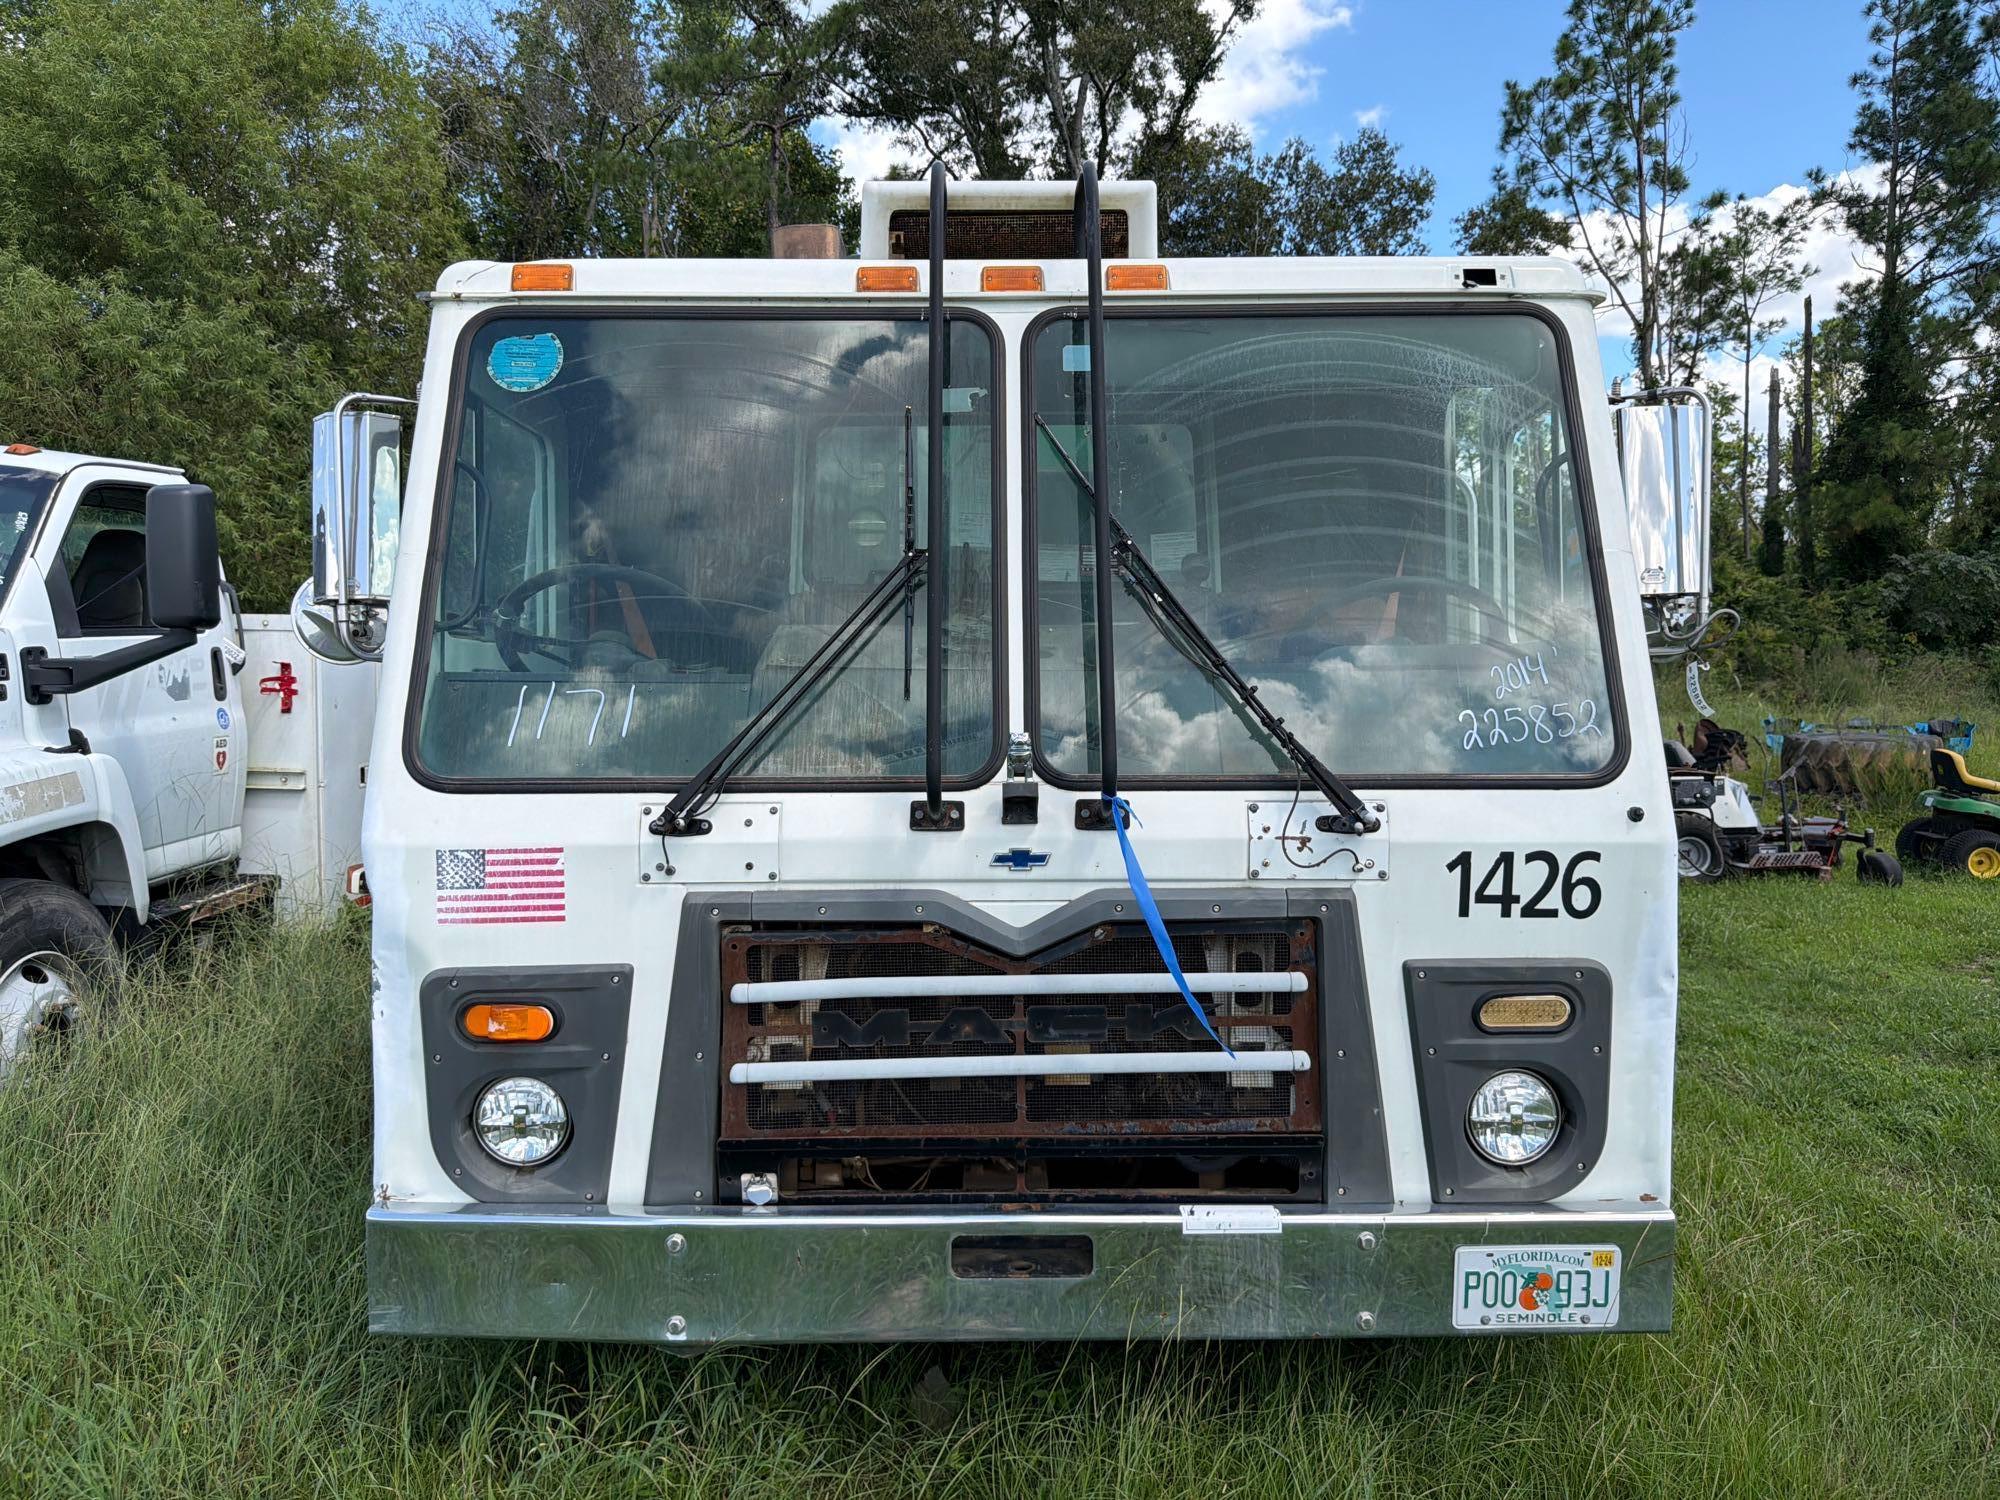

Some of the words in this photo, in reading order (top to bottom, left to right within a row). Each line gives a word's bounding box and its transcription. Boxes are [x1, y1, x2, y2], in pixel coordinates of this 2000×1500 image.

[1490, 652, 1549, 700] 2014
[507, 681, 636, 747] 1171
[1458, 699, 1603, 750] 225852
[215, 738, 228, 749] AED
[1445, 850, 1602, 920] 1426
[811, 1003, 1225, 1048] MACK
[1491, 1251, 1585, 1269] MYFLORIDA.COM
[1594, 1254, 1613, 1267] 12-24
[1554, 1270, 1610, 1309] 93J
[1495, 1312, 1578, 1324] SEMINOLE
